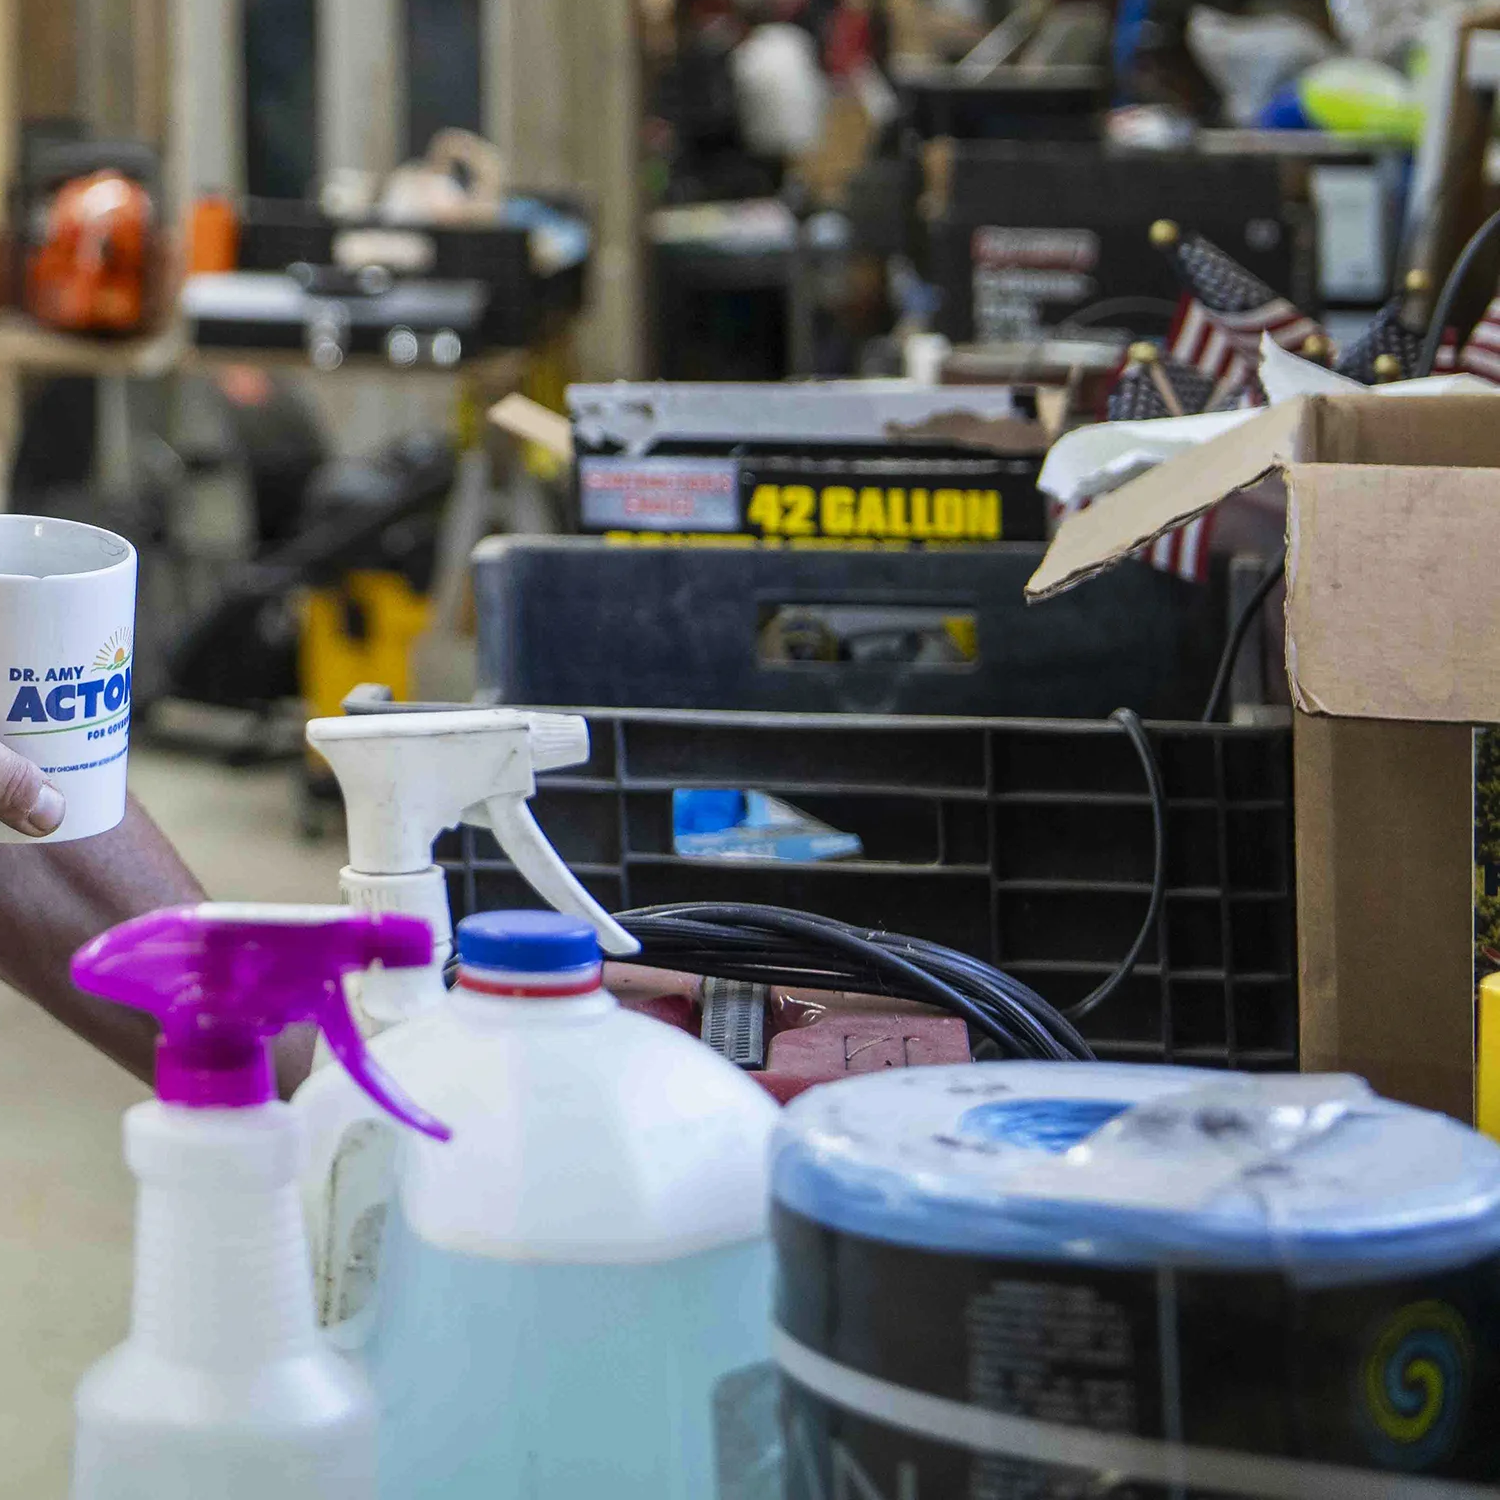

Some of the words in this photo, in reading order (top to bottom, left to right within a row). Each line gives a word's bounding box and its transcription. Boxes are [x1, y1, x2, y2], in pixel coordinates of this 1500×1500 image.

[748, 484, 817, 537] 42
[820, 485, 1002, 539] GALLON
[9, 668, 40, 682] DR.
[45, 666, 84, 682] AMY
[87, 728, 105, 741] FOR
